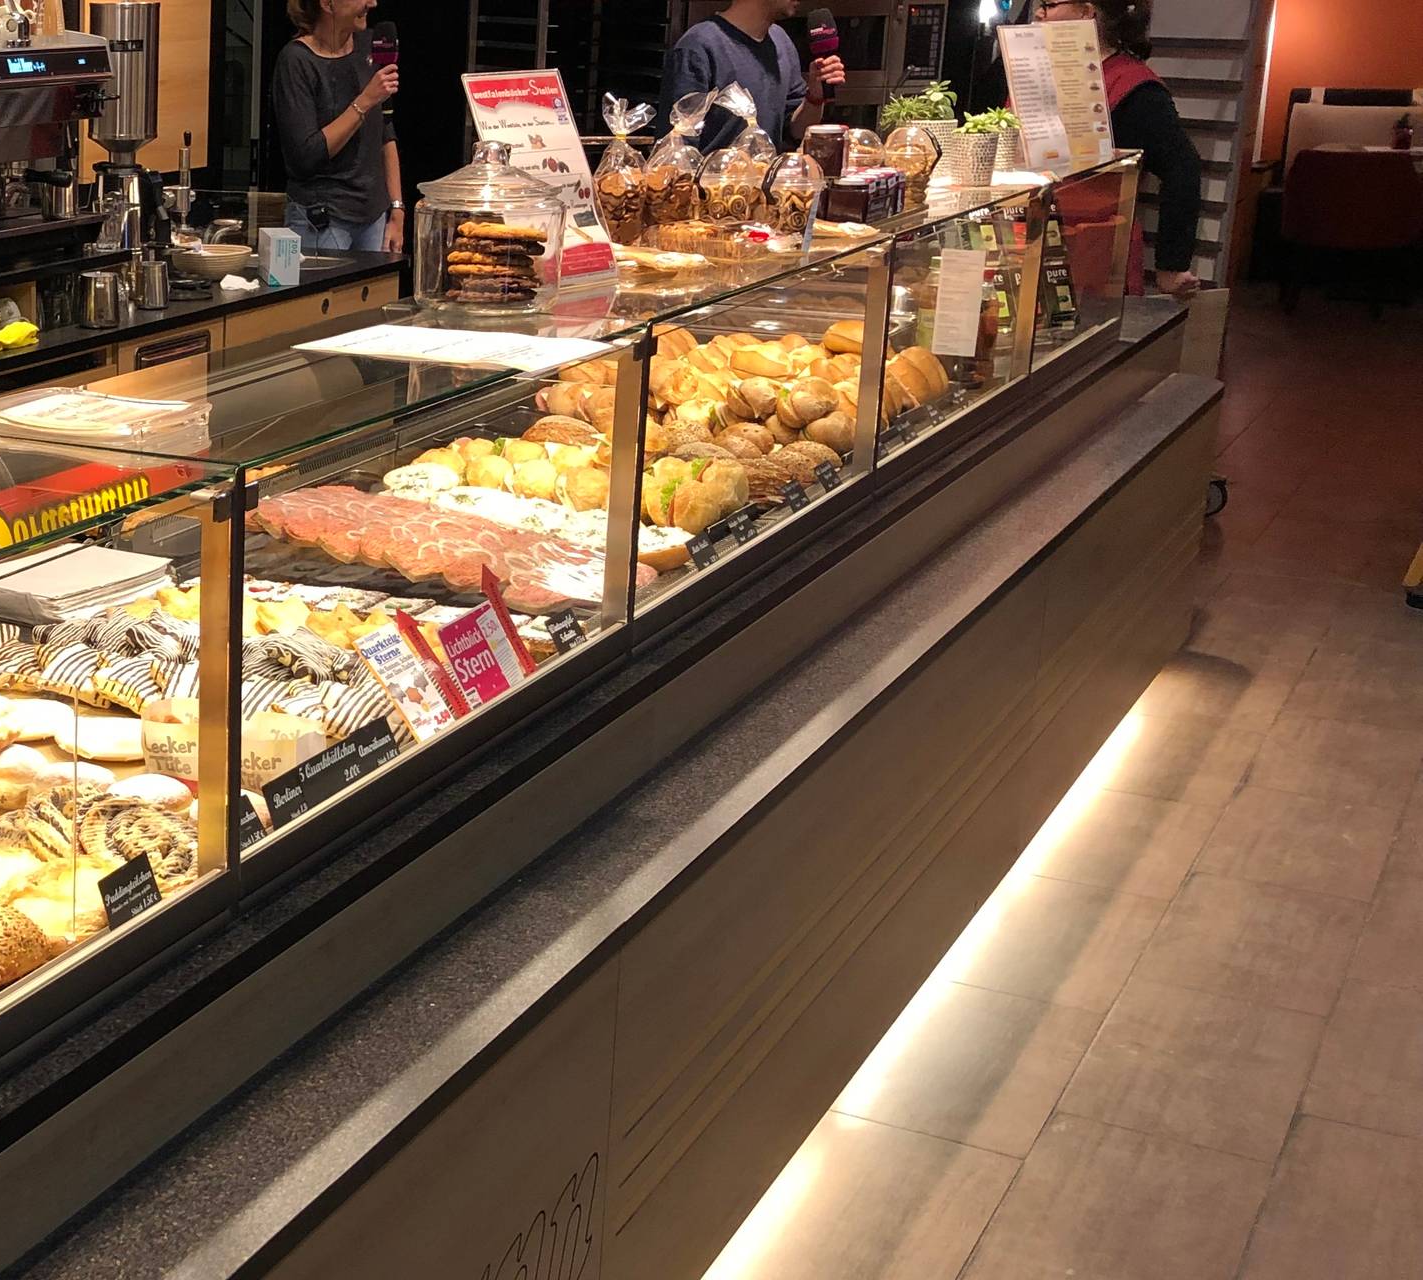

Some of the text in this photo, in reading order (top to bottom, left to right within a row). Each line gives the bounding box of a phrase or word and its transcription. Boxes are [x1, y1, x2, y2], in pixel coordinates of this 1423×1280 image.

[1003, 207, 1025, 220] pure
[1046, 267, 1068, 282] pure
[445, 627, 484, 658] Lichtblick
[374, 646, 402, 665] Sterne
[454, 649, 496, 683] Stern
[144, 733, 197, 754] Lecker
[358, 734, 392, 758] Amerikaner
[150, 755, 192, 775] Tüte
[298, 742, 356, 783] 5 Quarkbällchen
[273, 785, 303, 809] Berliner
